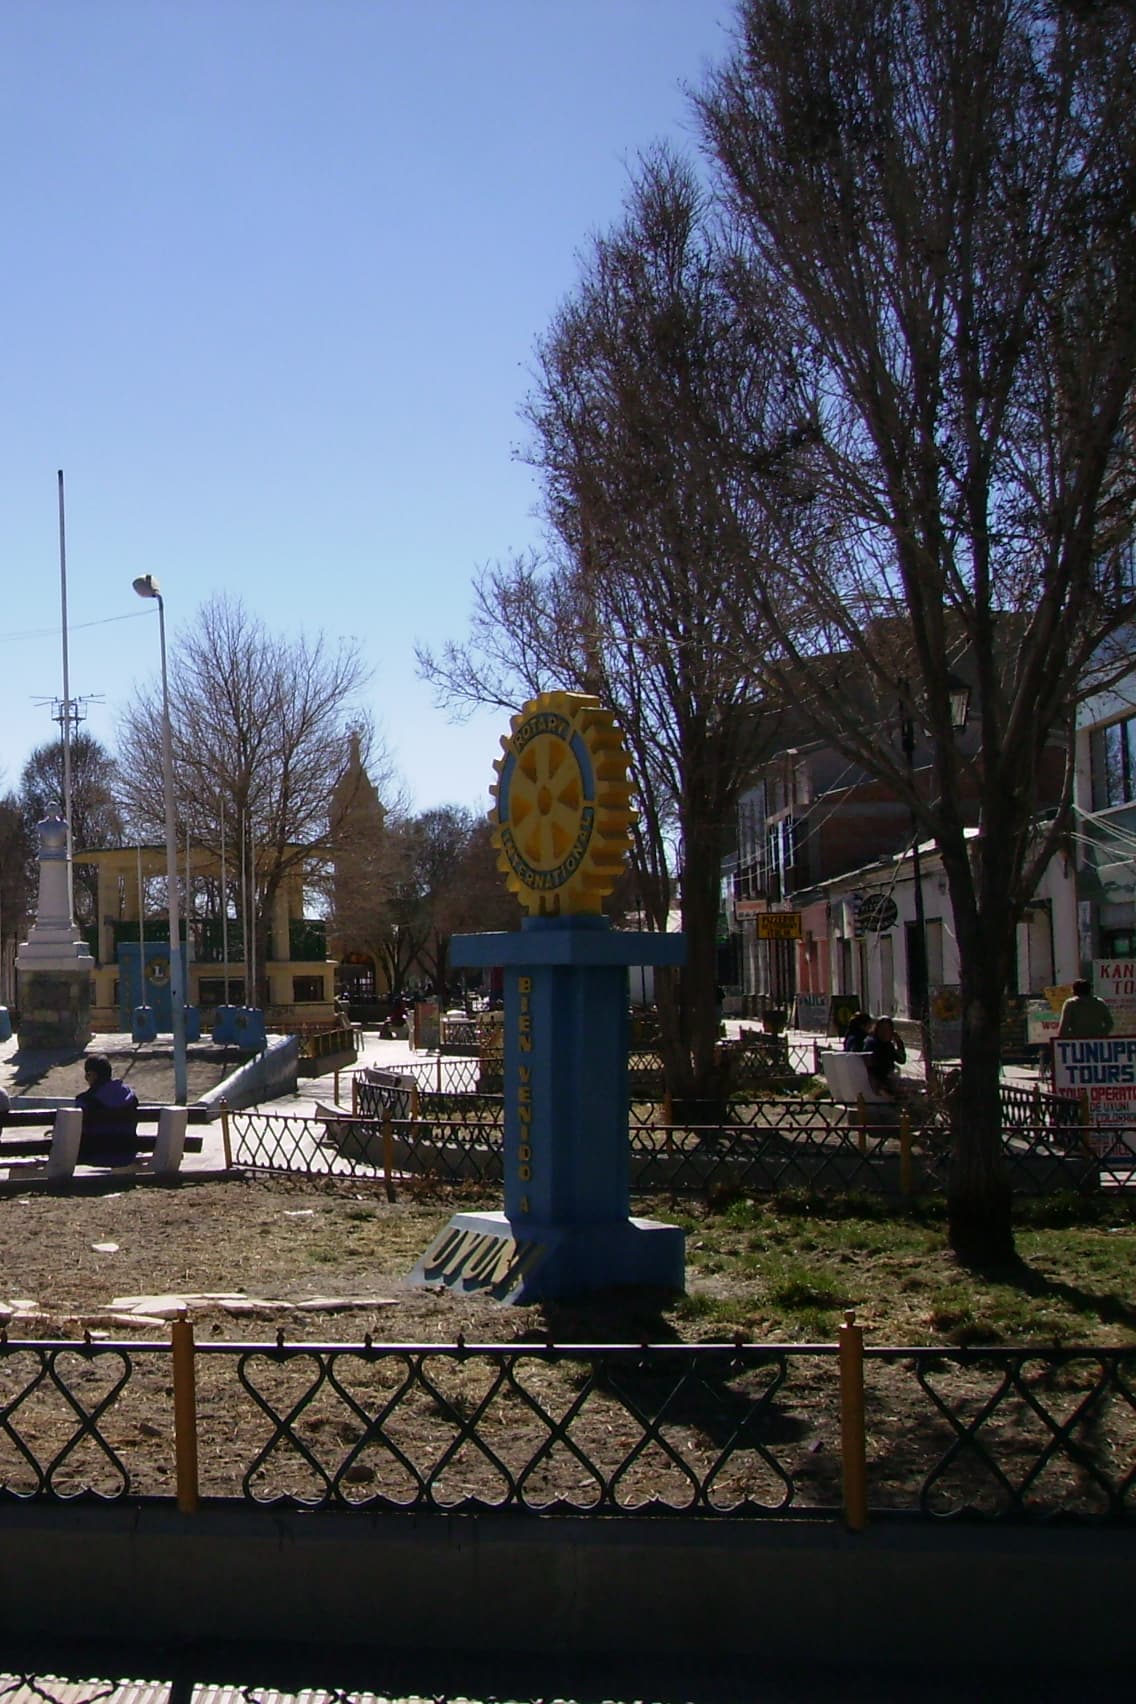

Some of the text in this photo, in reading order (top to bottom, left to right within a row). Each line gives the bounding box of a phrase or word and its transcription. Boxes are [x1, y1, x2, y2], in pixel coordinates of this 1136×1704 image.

[515, 714, 567, 748] ROTARY
[501, 813, 594, 889] INTERNATIONAL
[518, 975, 532, 1053] BIEN
[1065, 1065, 1135, 1084] TOURS
[518, 1065, 532, 1181] VENIDO
